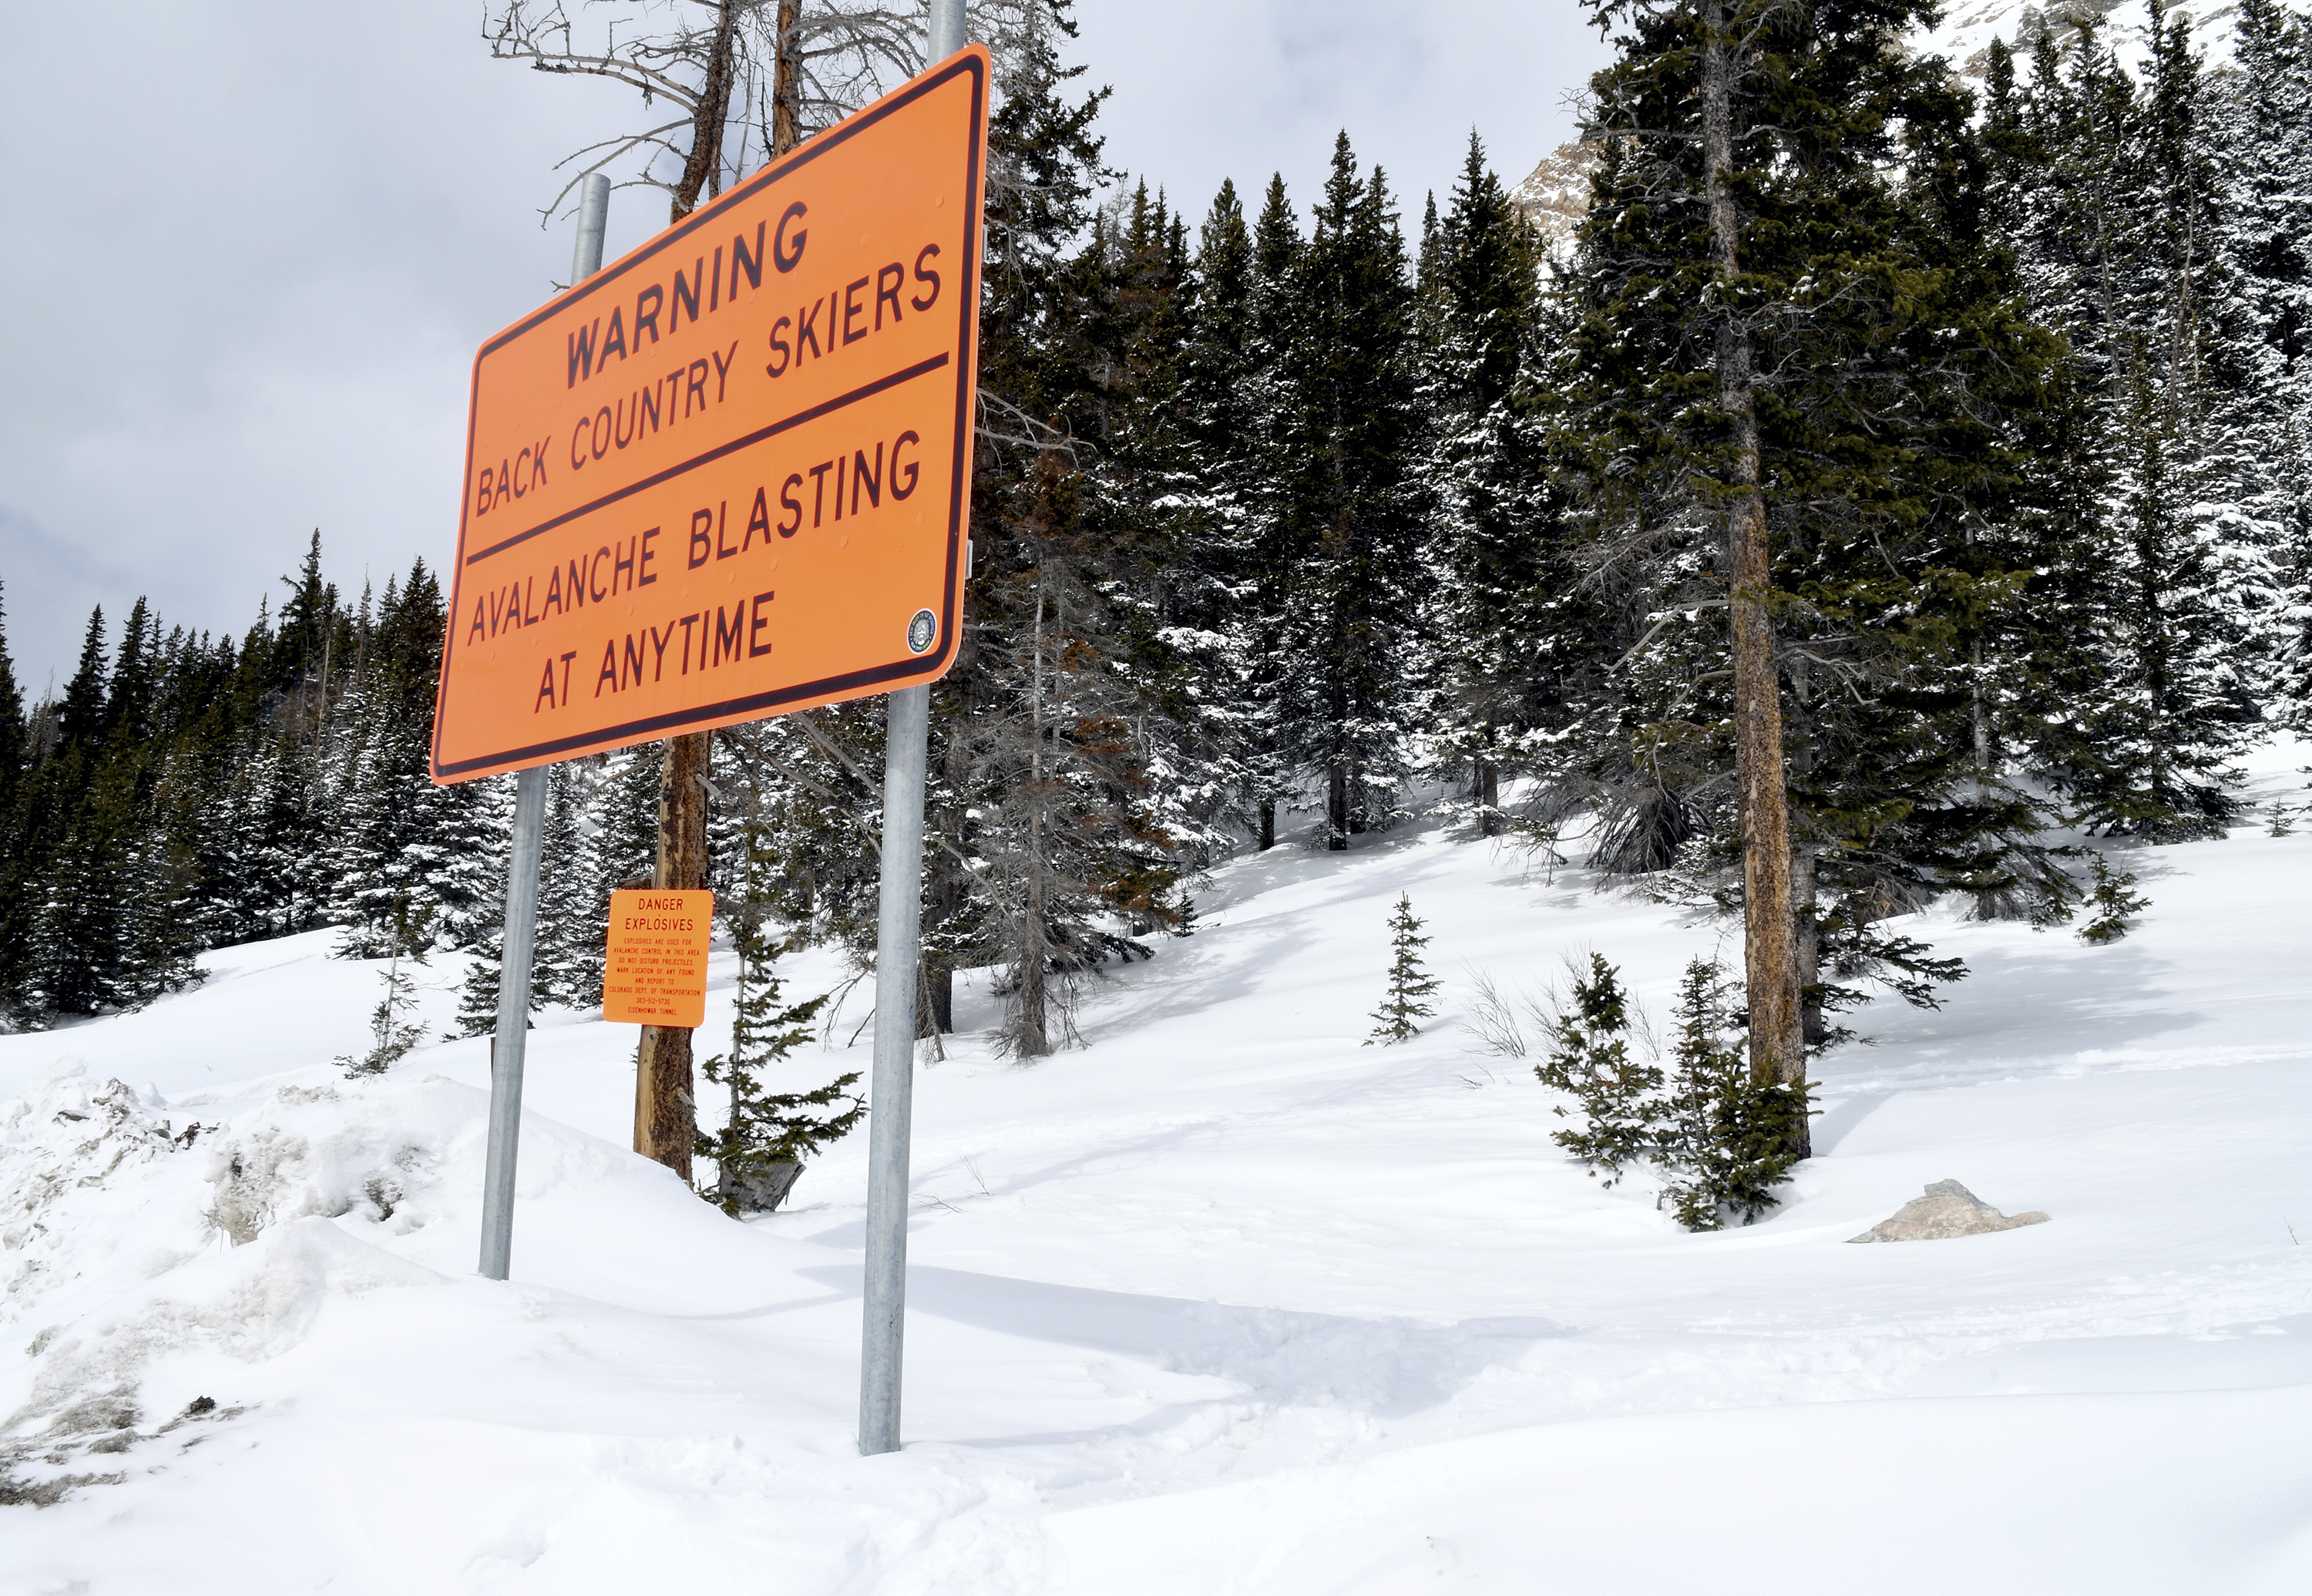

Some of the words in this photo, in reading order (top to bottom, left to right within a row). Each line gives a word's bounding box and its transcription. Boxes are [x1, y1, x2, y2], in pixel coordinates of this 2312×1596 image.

[569, 201, 807, 389] WARNING
[476, 436, 551, 518] BACK
[570, 340, 739, 471] COUNTRY
[766, 244, 941, 378] SKIERS
[467, 526, 660, 647] AVALANCHE
[688, 430, 920, 570] BLASTING
[534, 651, 577, 714] AT
[595, 590, 775, 699] ANYTIME
[625, 919, 694, 931] EXPLOSIVES
[638, 899, 684, 910] DANGER
